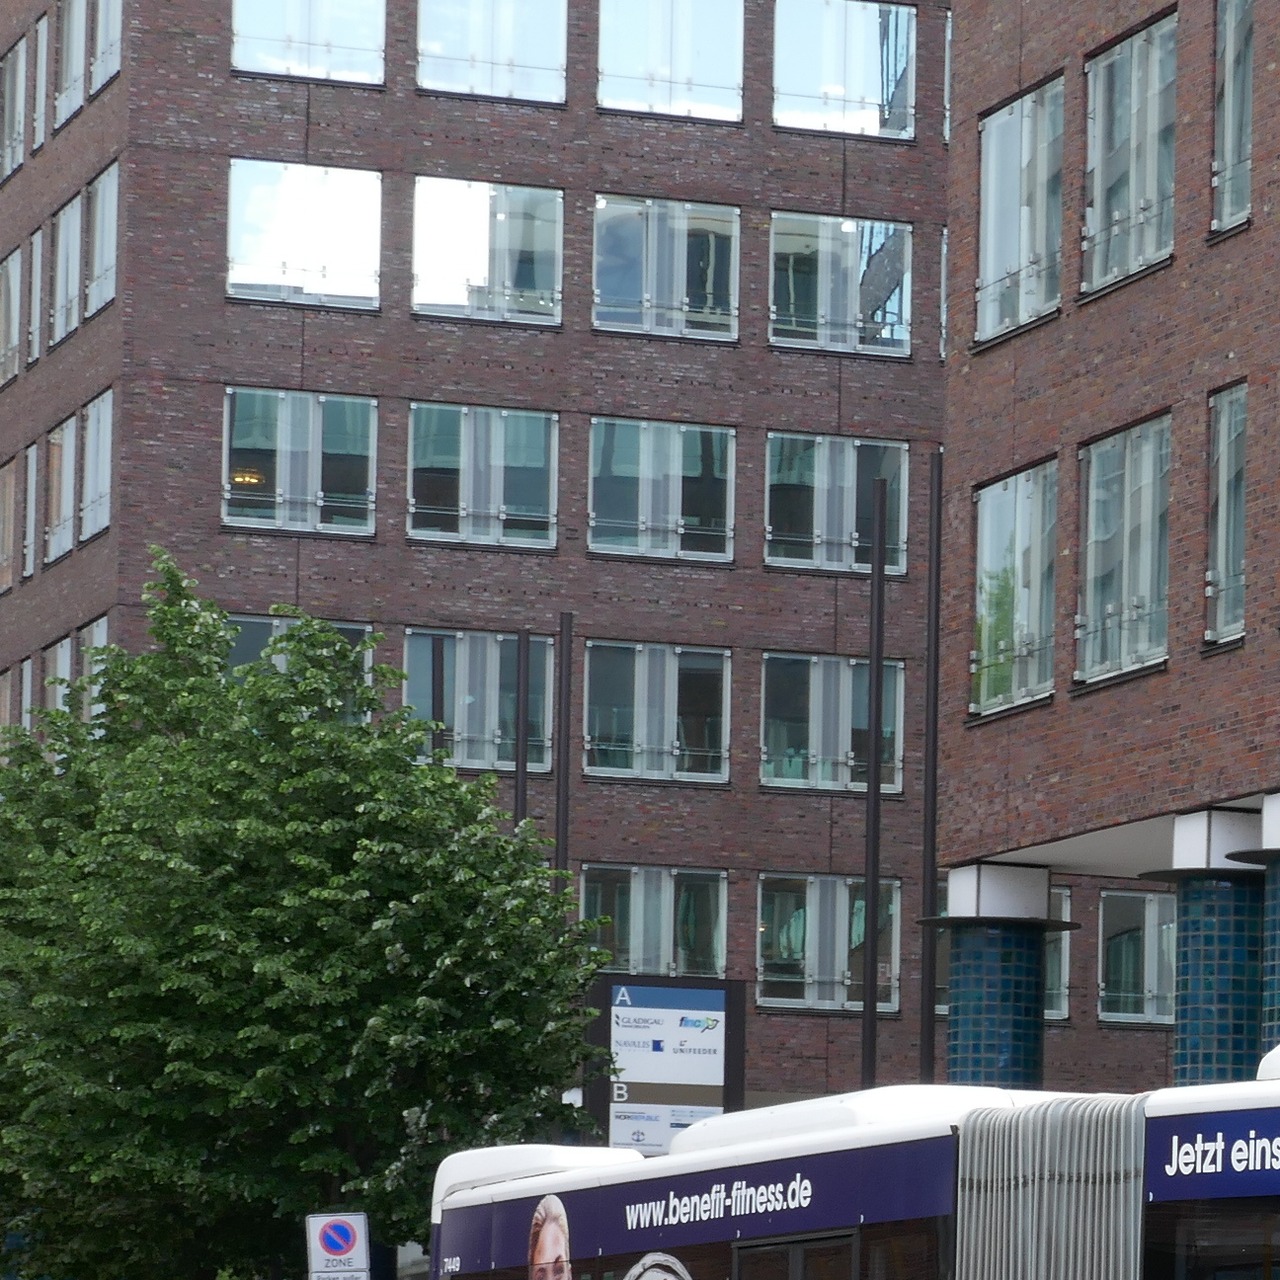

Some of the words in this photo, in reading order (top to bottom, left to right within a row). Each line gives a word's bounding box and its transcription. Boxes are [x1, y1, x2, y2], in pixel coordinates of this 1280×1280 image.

[614, 986, 632, 1006] A
[672, 1047, 718, 1055] UNIFEEDER
[613, 1083, 629, 1102] B
[1165, 1131, 1225, 1177] Jetzt
[625, 1172, 812, 1230] www.benefit-fitness.de
[324, 1257, 354, 1268] ZONE
[443, 1256, 461, 1273] 7449
